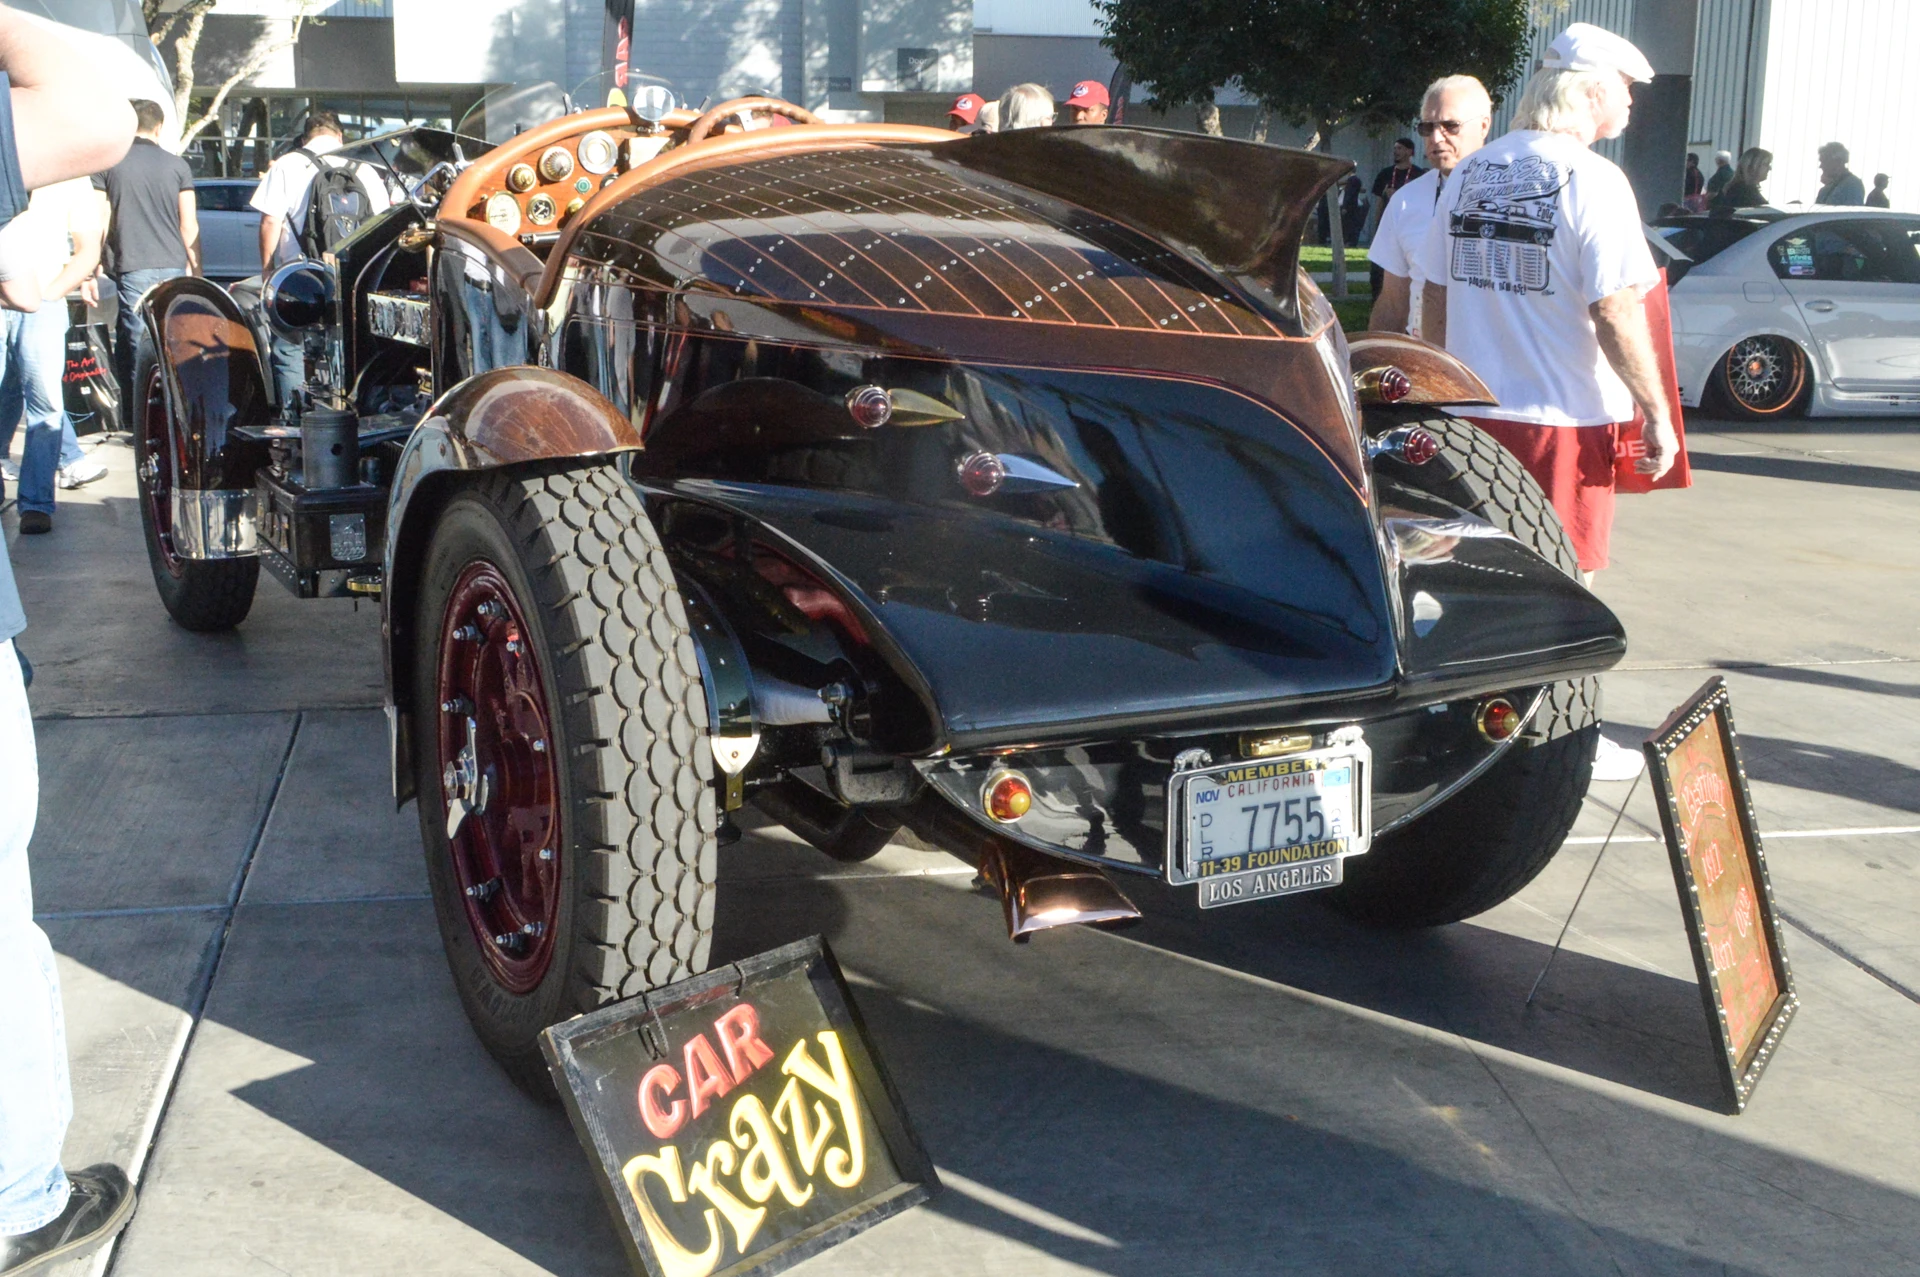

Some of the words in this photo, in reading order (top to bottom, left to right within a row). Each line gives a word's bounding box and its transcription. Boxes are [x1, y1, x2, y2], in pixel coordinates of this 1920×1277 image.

[908, 57, 927, 65] Door
[66, 359, 79, 370] The
[81, 356, 96, 368] Art
[1227, 759, 1316, 782] MEMBER
[1195, 789, 1219, 804] NOV
[1227, 775, 1316, 798] CALIFORNIA
[1241, 796, 1325, 852] 7755
[1209, 880, 1243, 902] LOS
[1253, 864, 1333, 894] ANGELES
[637, 1003, 775, 1139] CAR
[622, 1030, 866, 1277] Crazy
